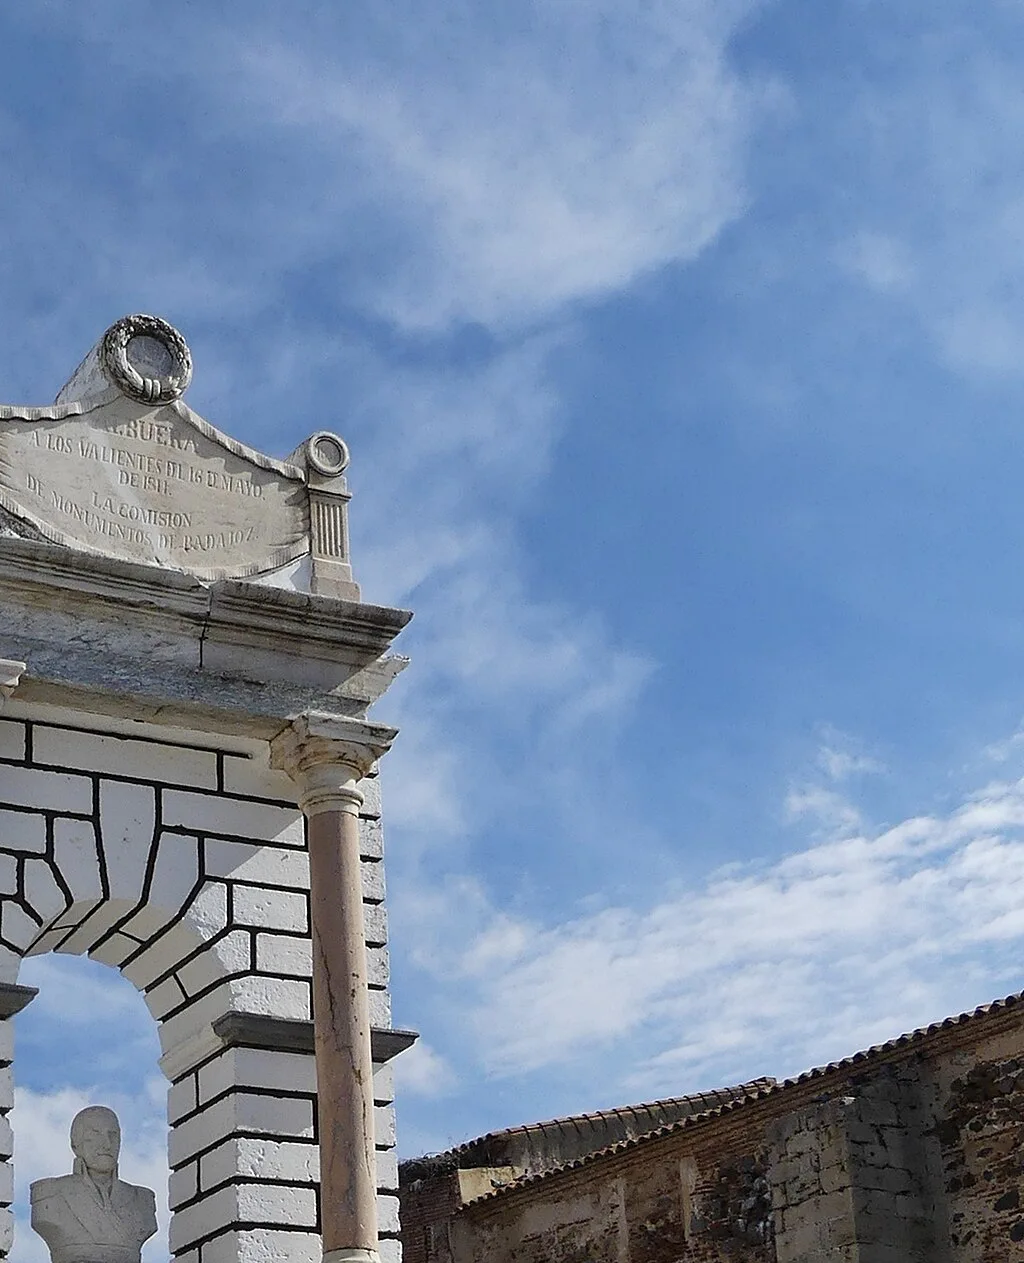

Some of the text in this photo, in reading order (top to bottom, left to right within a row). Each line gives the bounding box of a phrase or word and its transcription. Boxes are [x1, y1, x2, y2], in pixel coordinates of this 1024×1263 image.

[30, 430, 40, 447] A
[46, 433, 73, 454] LOS
[78, 440, 164, 474] VALIENTES
[189, 466, 202, 483] 16
[119, 469, 139, 488] DE
[26, 472, 46, 498] DE
[51, 490, 154, 545] MONUMENTOS
[157, 533, 178, 549] DE
[91, 491, 192, 527] LA COMISION
